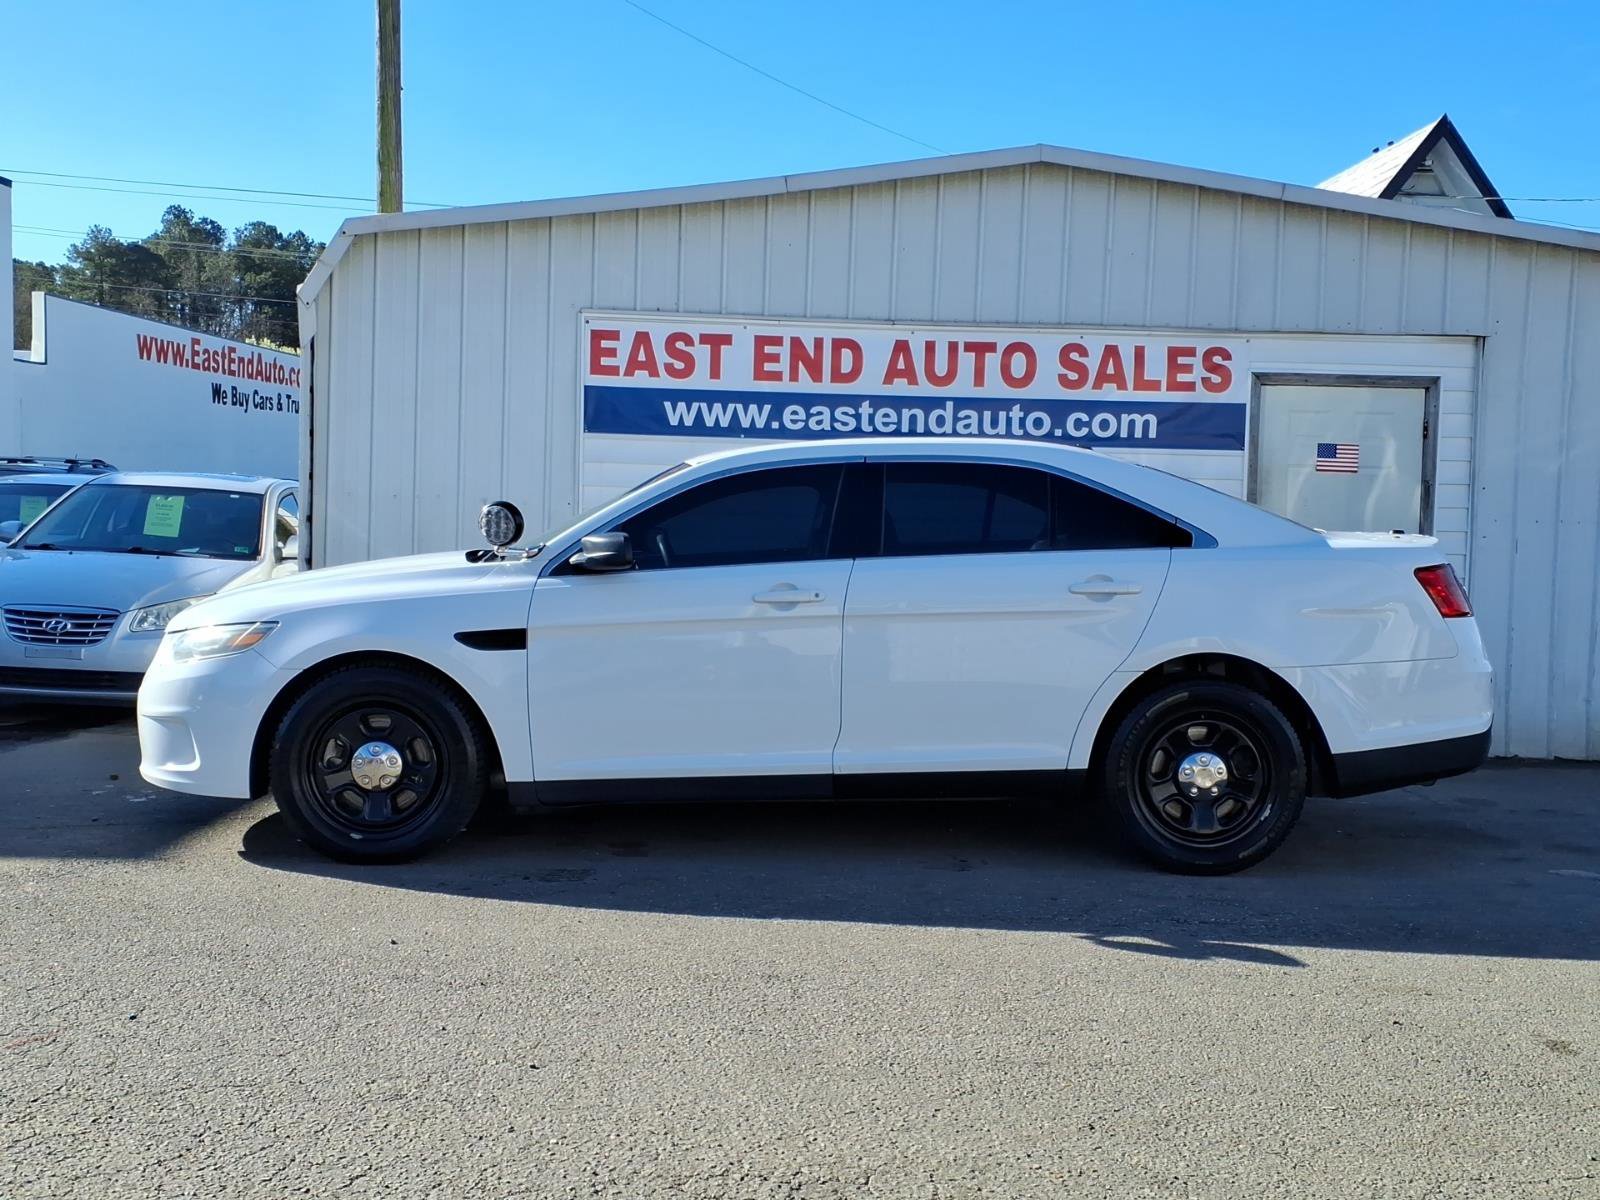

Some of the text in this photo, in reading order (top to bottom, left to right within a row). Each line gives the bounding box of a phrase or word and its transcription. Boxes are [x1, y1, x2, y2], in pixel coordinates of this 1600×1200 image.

[589, 328, 1234, 394] EAST END AUTO SALES
[211, 383, 228, 406] We
[231, 385, 250, 414] Buy
[252, 389, 274, 412] Cars
[276, 392, 283, 413] &
[663, 399, 1159, 440] www.eastendauto.com
